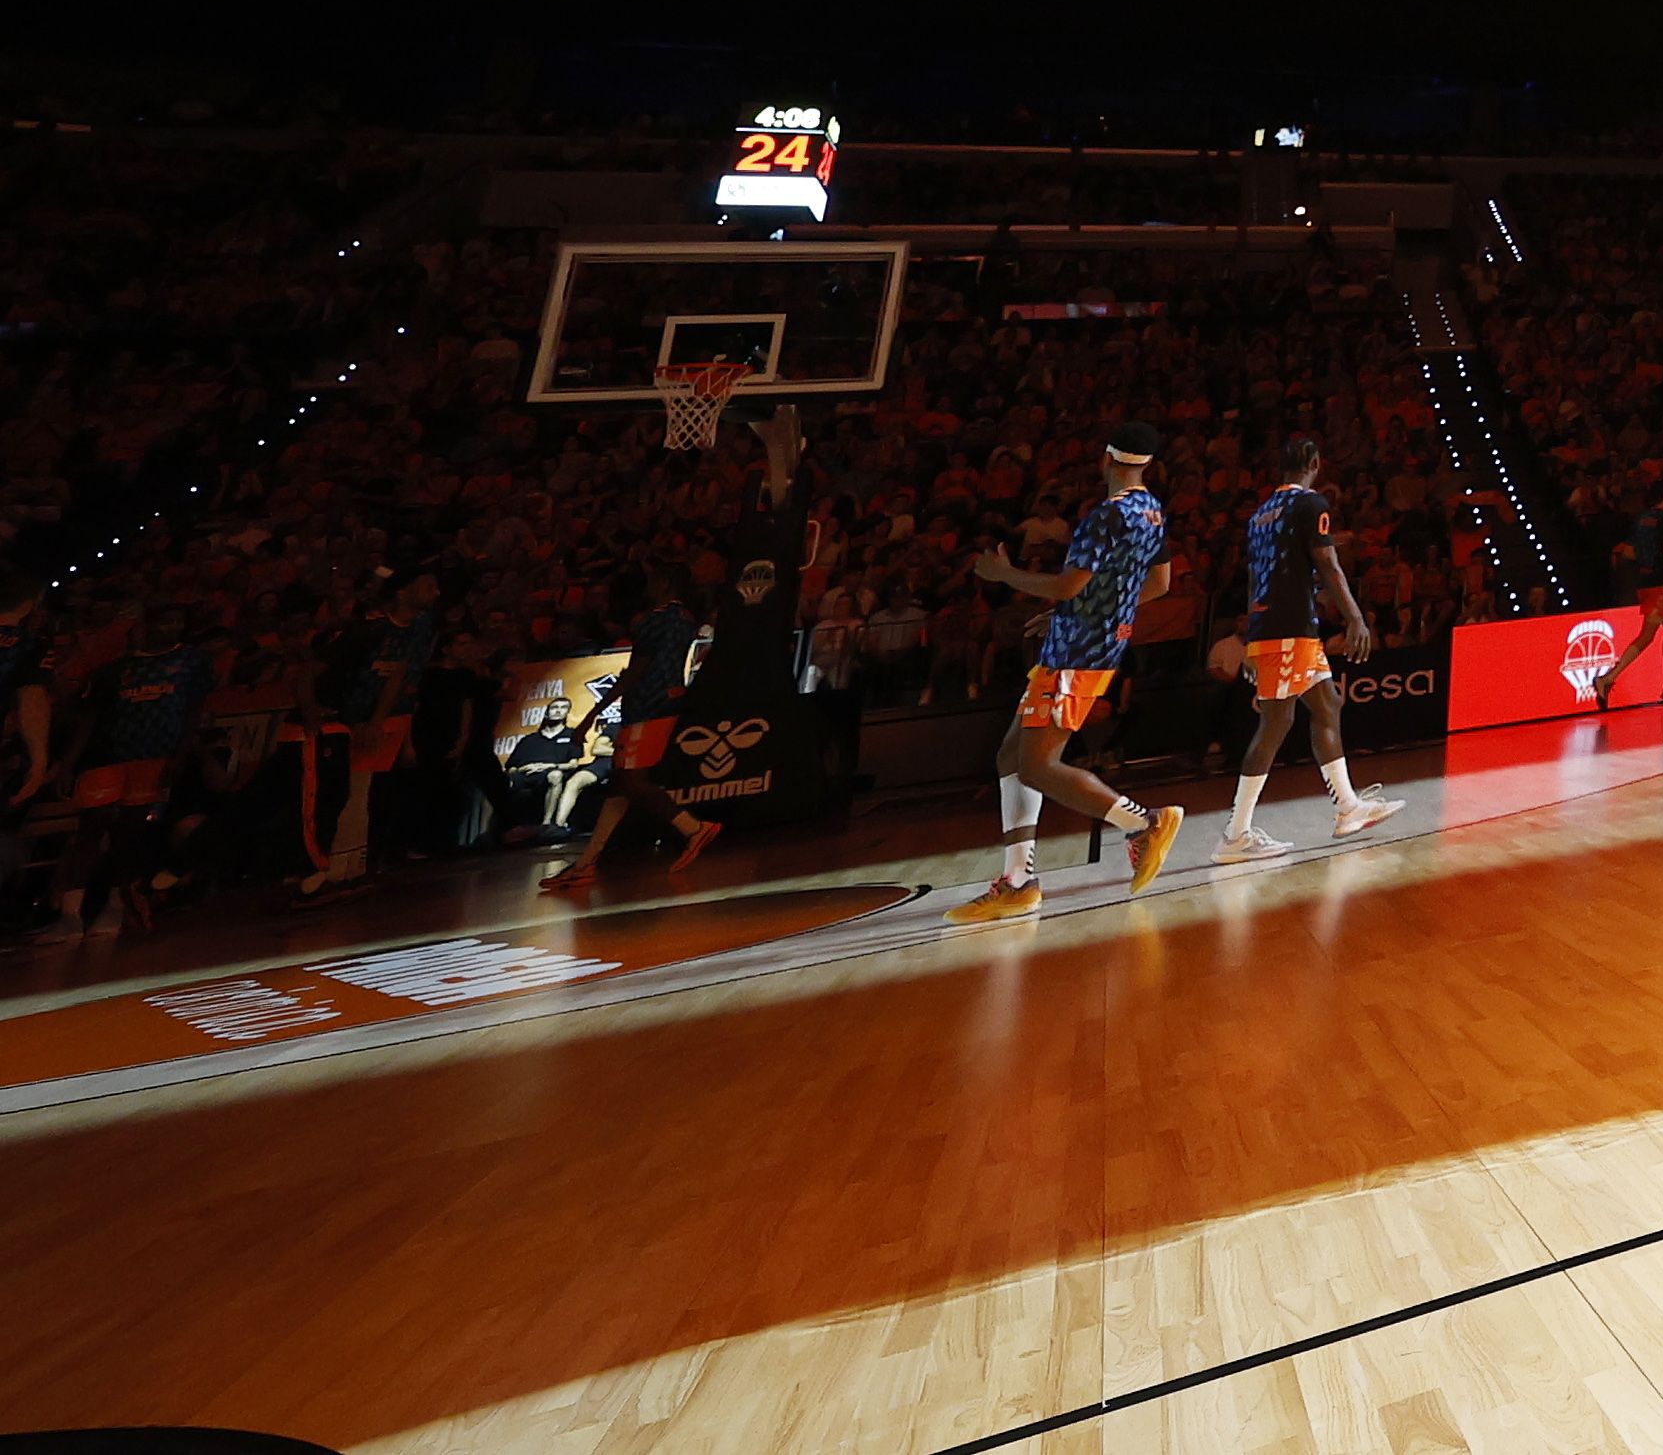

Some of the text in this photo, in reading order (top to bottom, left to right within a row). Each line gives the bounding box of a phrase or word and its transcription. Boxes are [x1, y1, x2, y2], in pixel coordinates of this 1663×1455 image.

[735, 133, 811, 173] 24
[667, 770, 774, 806] ummel
[303, 938, 623, 1006] PAMESA
